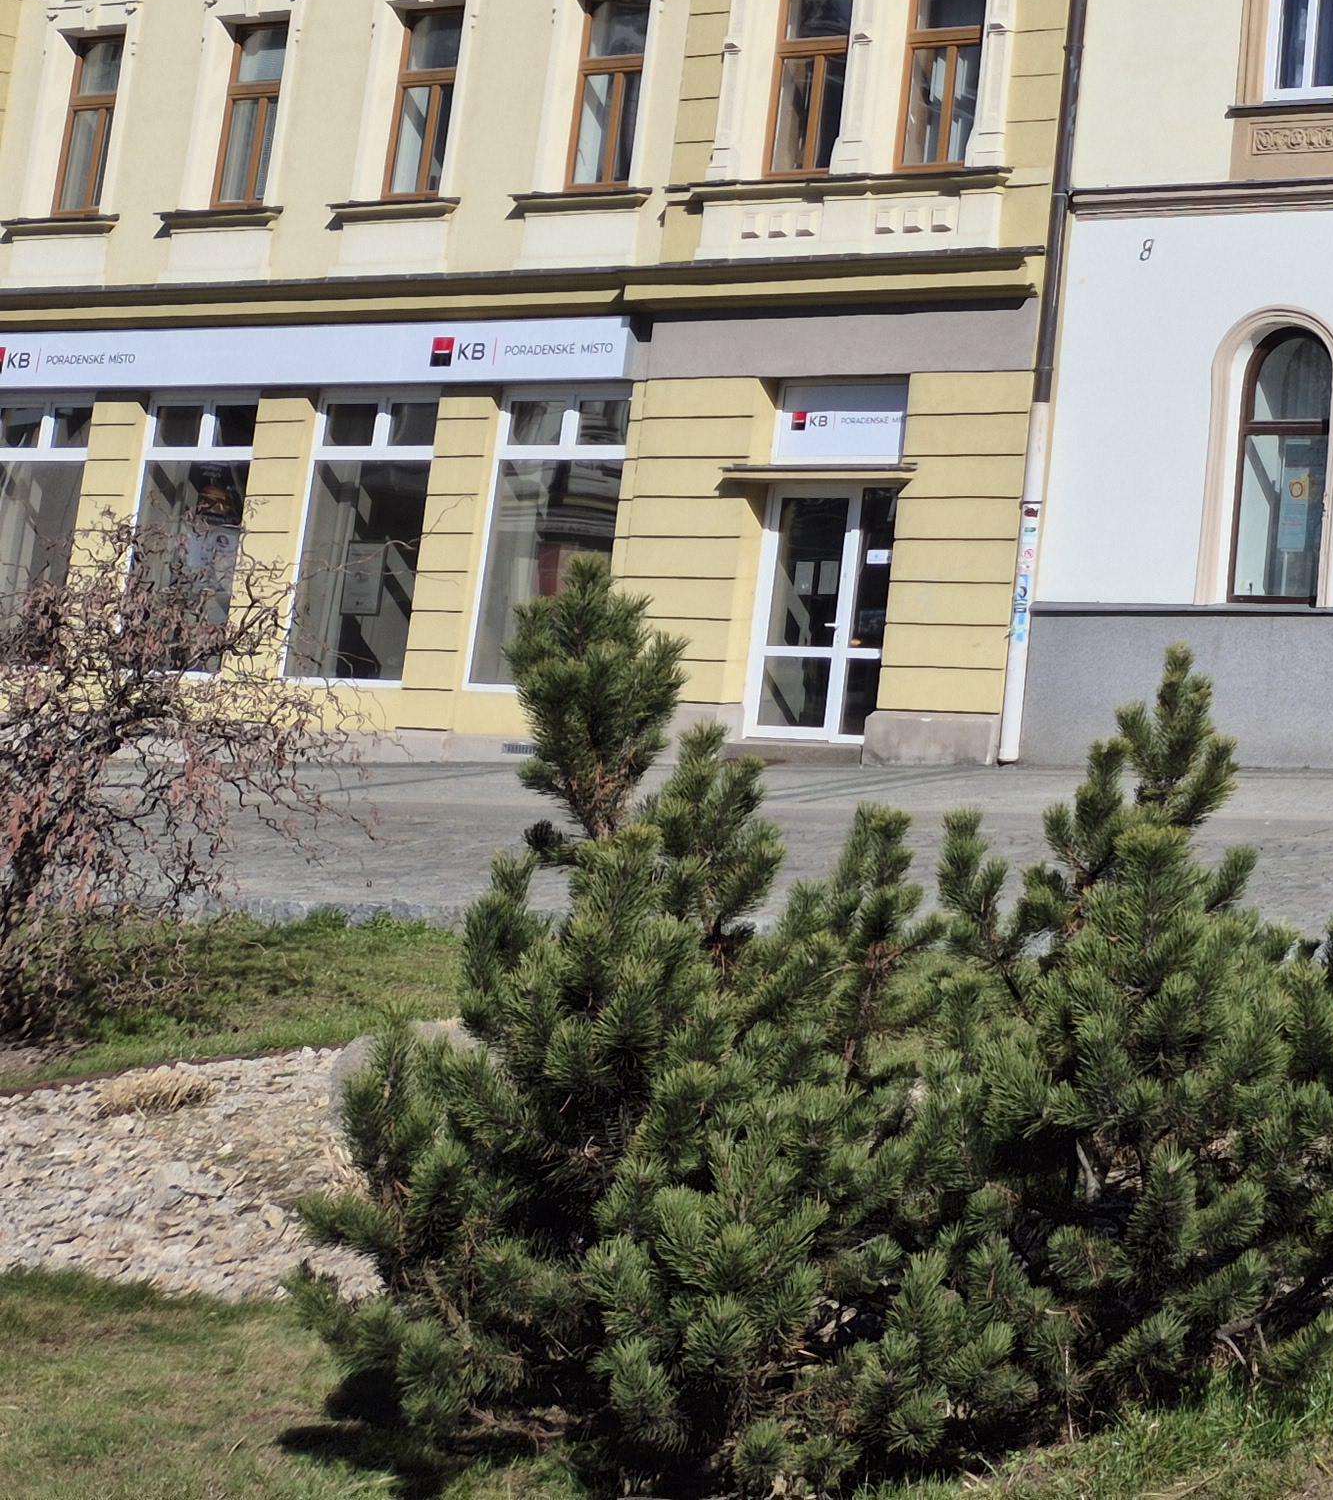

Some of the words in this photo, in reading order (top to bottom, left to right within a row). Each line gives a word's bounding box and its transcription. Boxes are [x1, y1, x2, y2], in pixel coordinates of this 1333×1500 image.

[457, 342, 486, 361] KB
[504, 341, 576, 357] PORADENSKÉ
[580, 340, 614, 354] MÍSTO
[6, 352, 31, 369] KB
[46, 352, 106, 365] PORADENSKÉ
[108, 352, 136, 364] MÍSTO
[809, 415, 828, 428] KB
[841, 416, 889, 425] PORADENSKÉ
